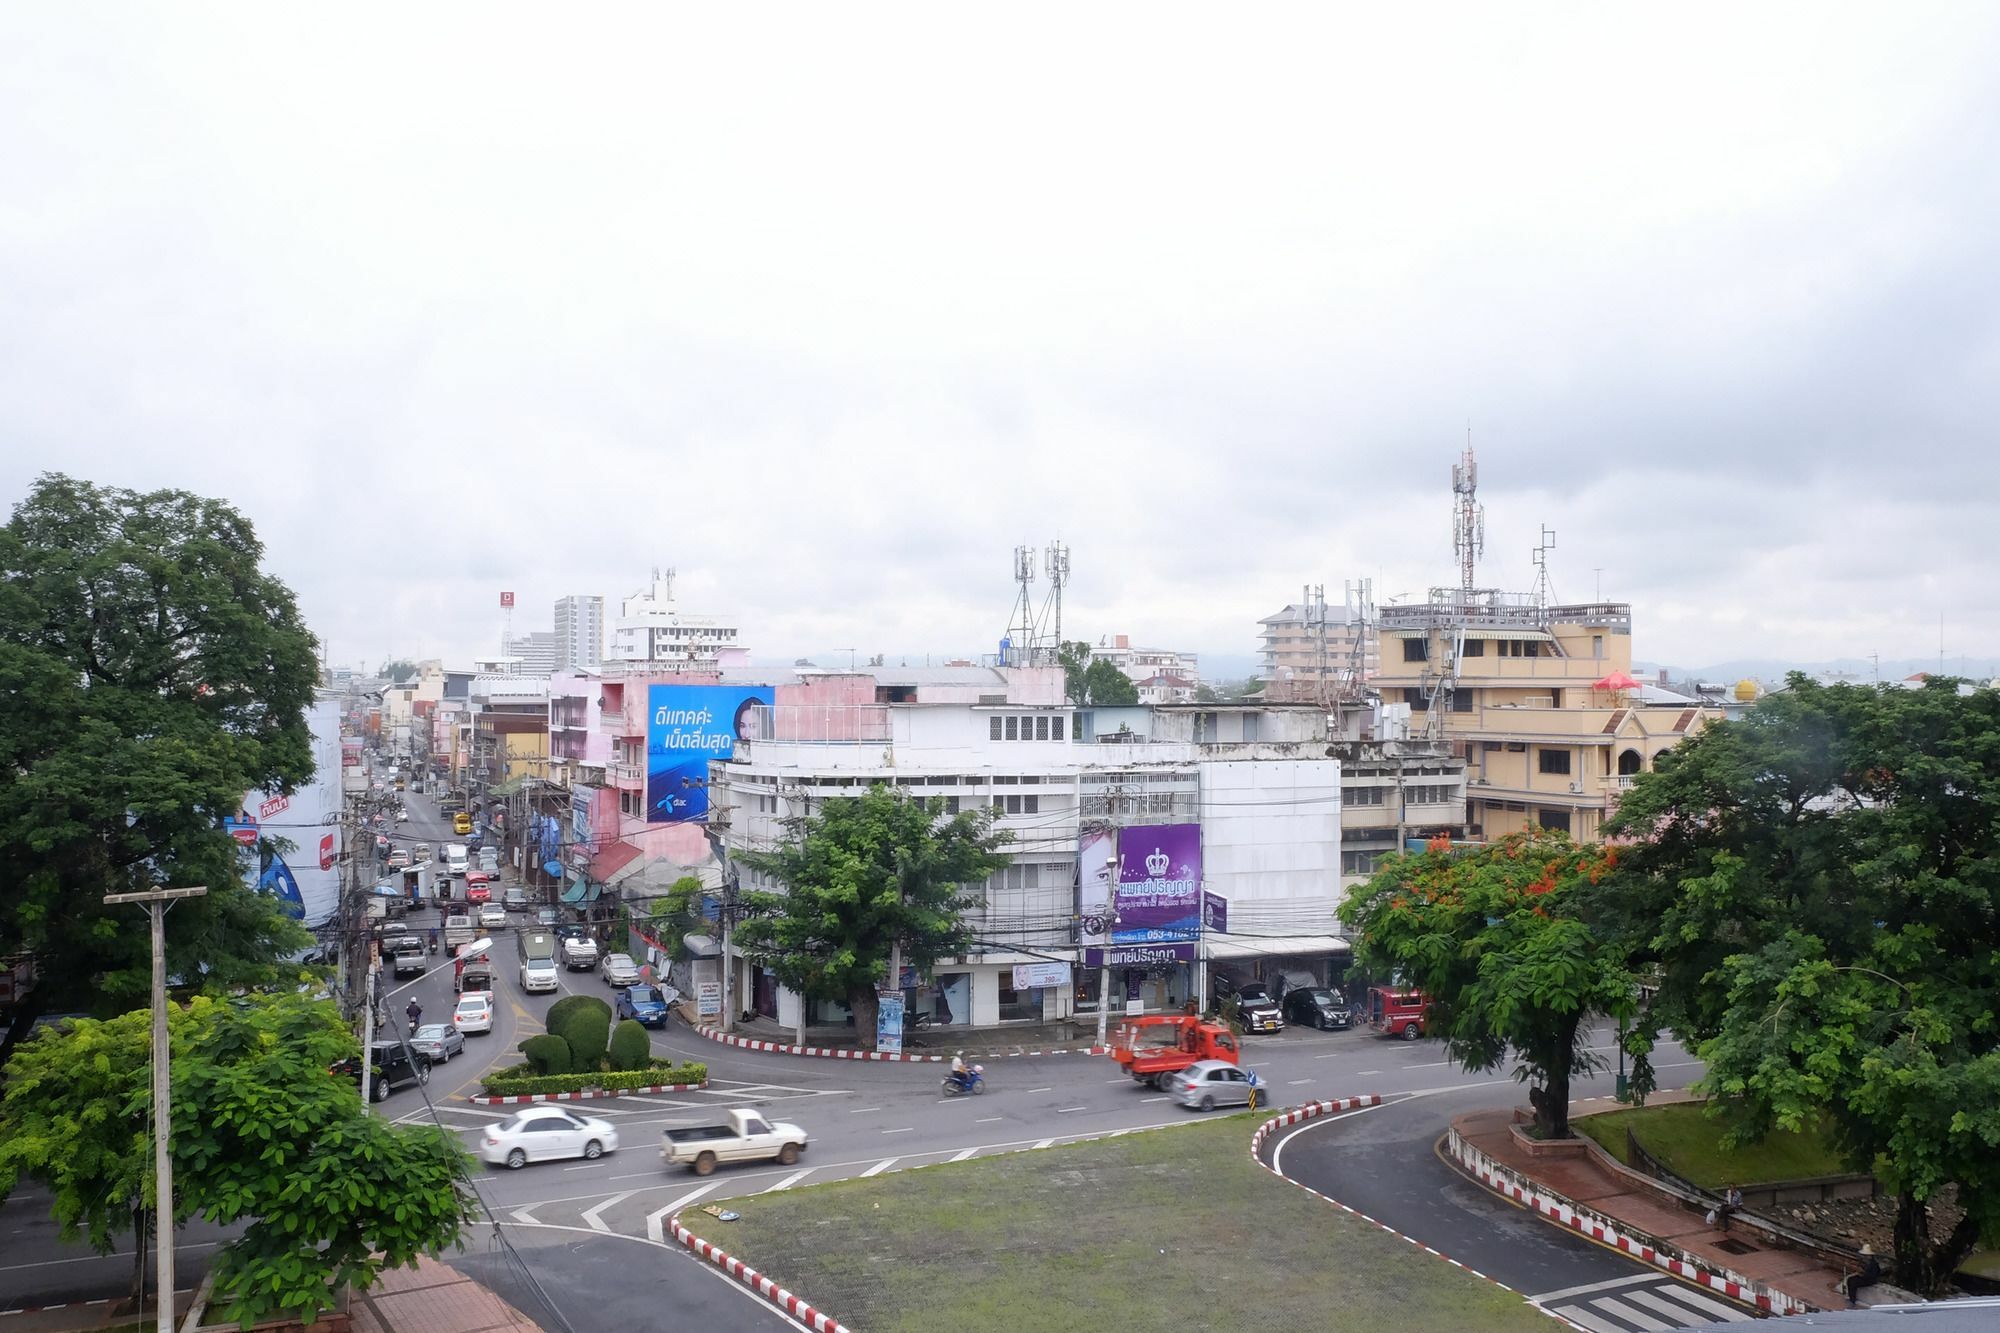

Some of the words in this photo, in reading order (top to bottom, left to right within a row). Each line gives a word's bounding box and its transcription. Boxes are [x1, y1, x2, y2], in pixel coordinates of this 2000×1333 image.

[655, 705, 712, 726] ดีแทคค่ะ
[665, 727, 731, 755] เน็ตลื่นสุด
[1119, 878, 1195, 897] แพทย์ปริญญา
[1111, 948, 1176, 965] พทย์ปริญญา
